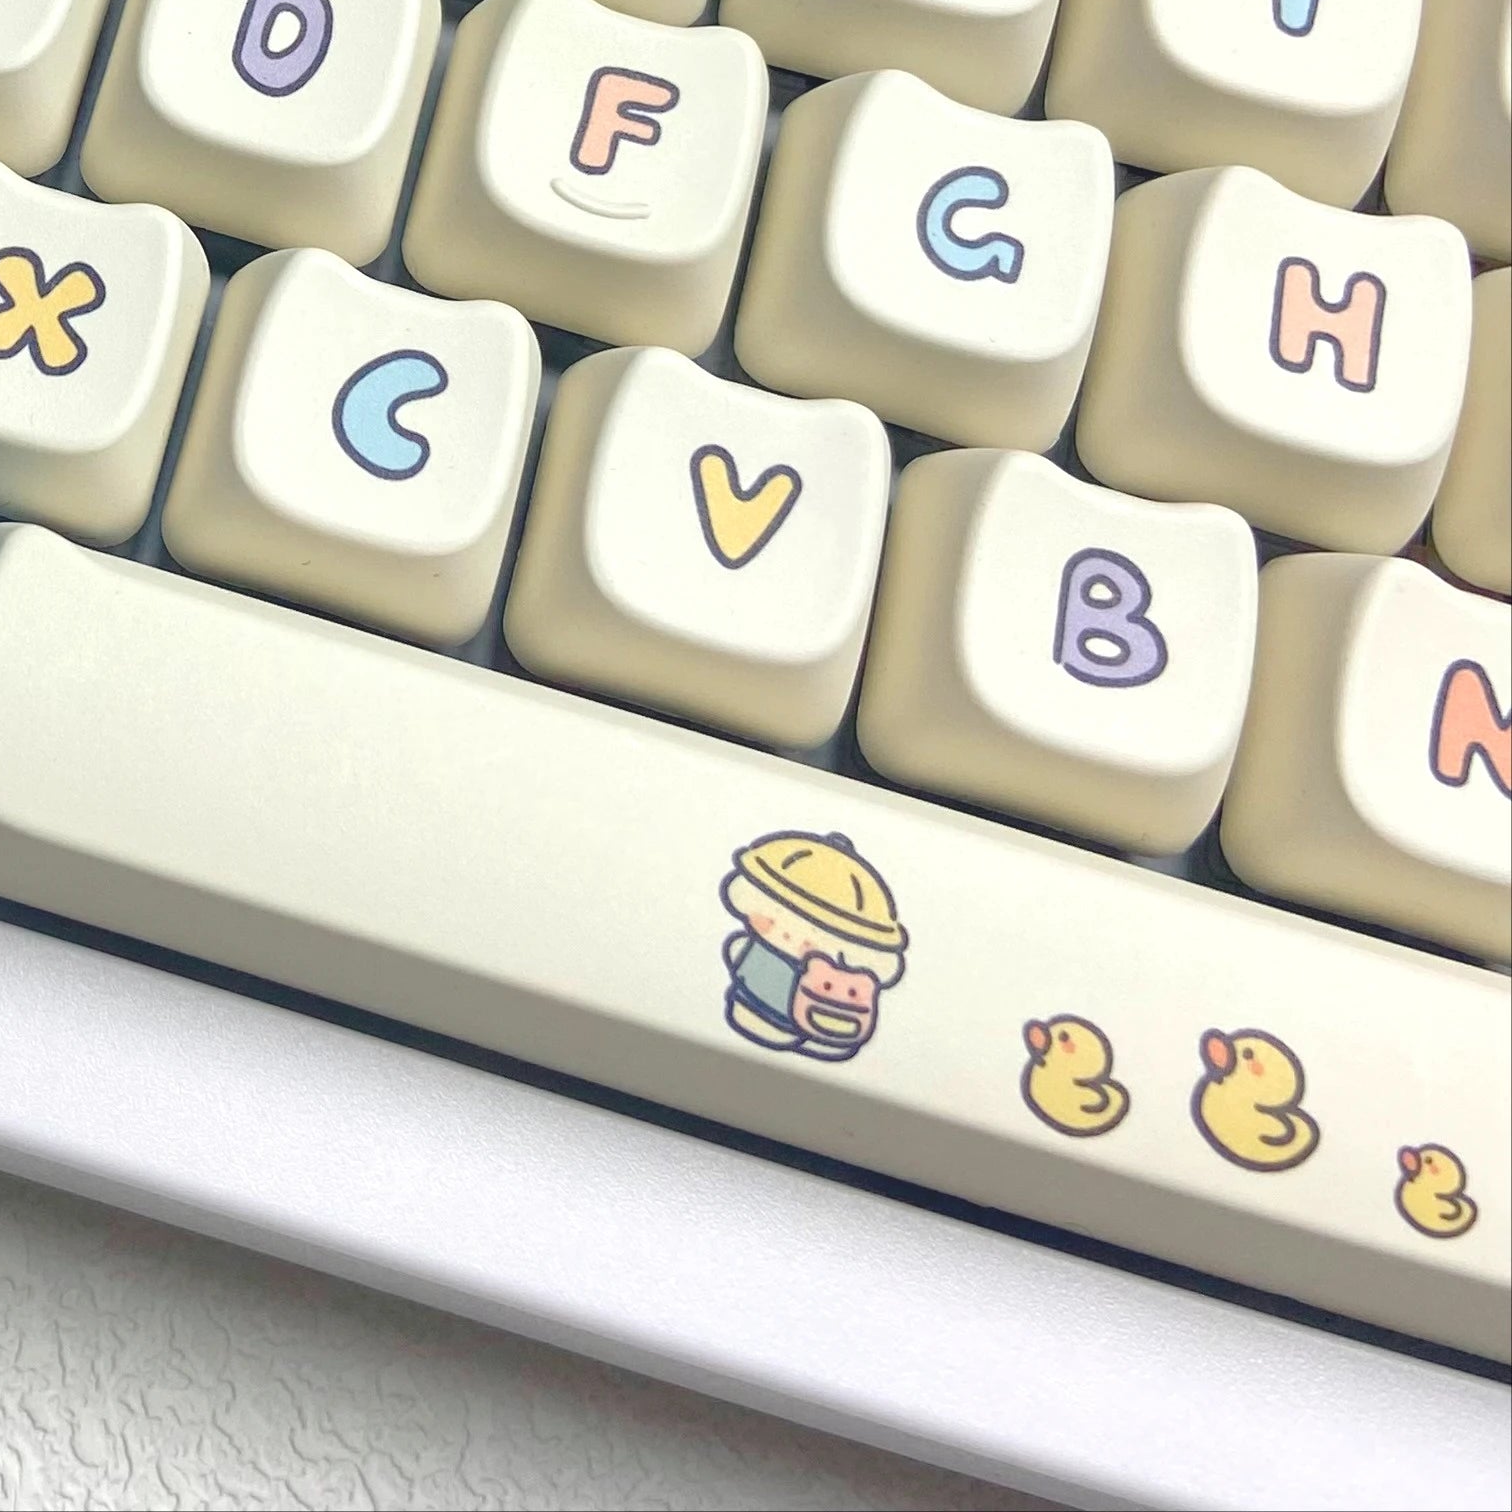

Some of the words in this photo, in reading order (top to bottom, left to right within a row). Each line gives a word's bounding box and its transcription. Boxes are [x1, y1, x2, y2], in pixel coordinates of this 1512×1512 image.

[570, 67, 680, 175] F
[917, 166, 1024, 284] G
[1269, 257, 1386, 393] H
[332, 350, 448, 480] C
[690, 444, 802, 569] V
[1053, 548, 1168, 688] B
